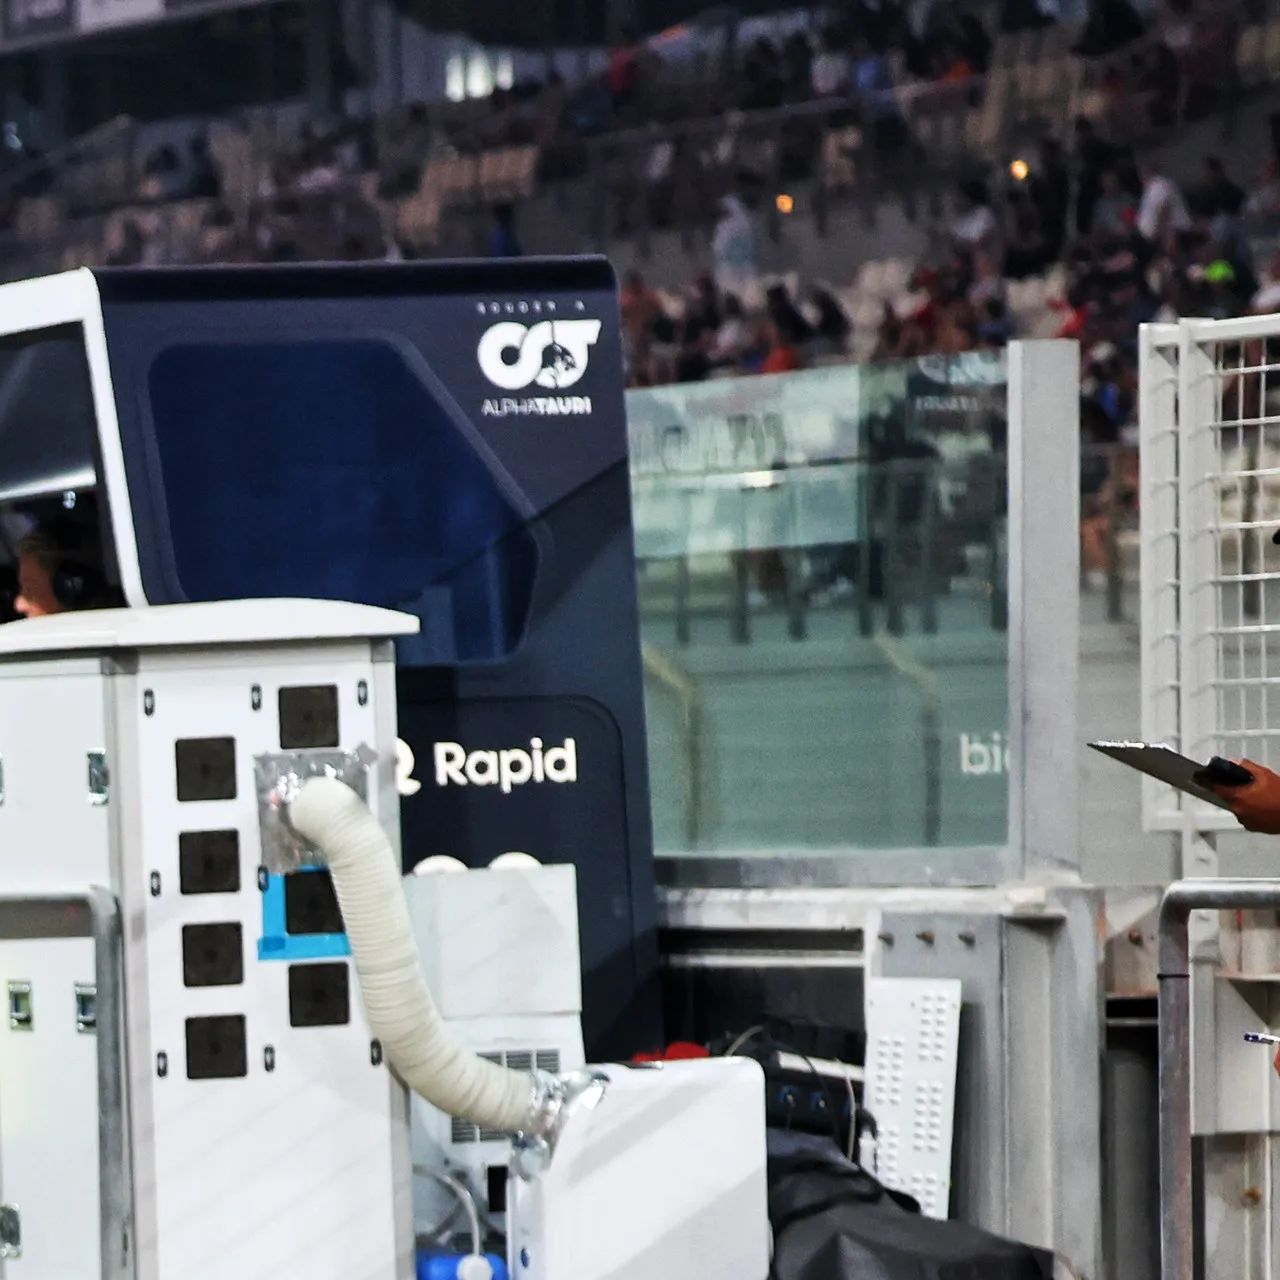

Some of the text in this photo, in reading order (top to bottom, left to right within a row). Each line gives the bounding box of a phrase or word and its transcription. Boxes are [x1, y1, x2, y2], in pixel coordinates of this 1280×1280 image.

[481, 396, 593, 417] ALPHATAURI
[433, 737, 578, 794] Rapid
[960, 731, 1008, 775] bi
